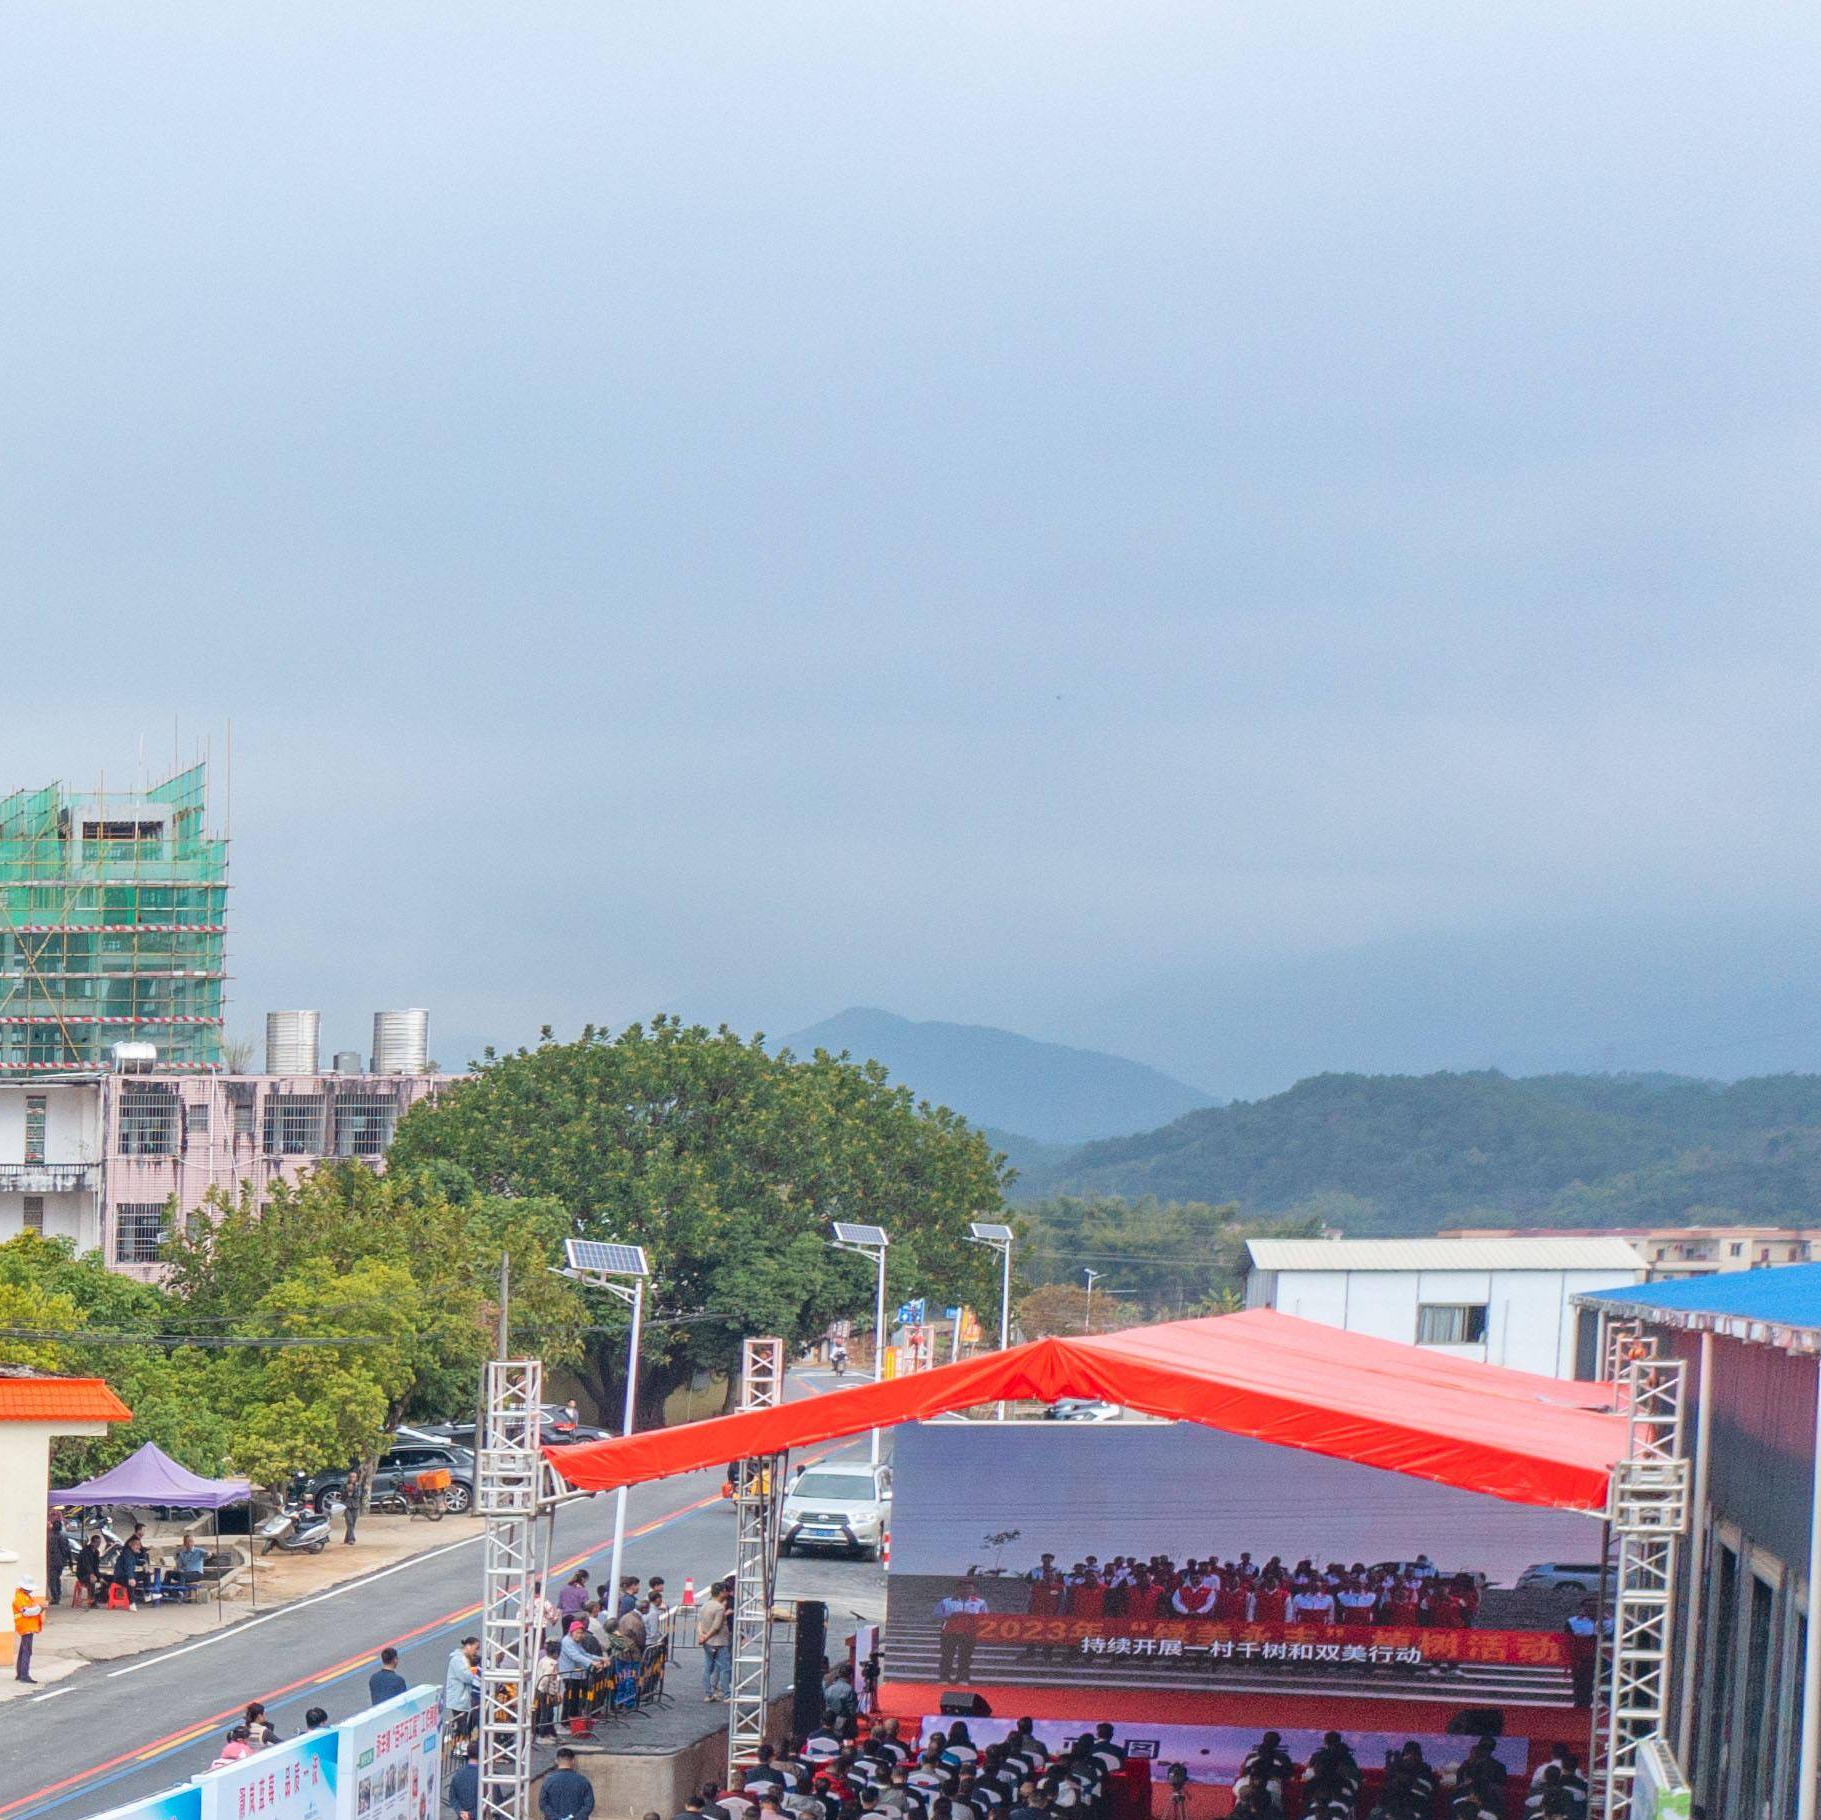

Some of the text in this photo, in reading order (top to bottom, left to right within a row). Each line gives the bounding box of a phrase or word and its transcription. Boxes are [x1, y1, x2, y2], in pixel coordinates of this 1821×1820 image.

[1081, 1636, 1422, 1664] 持续开展一村千树和双美行动
